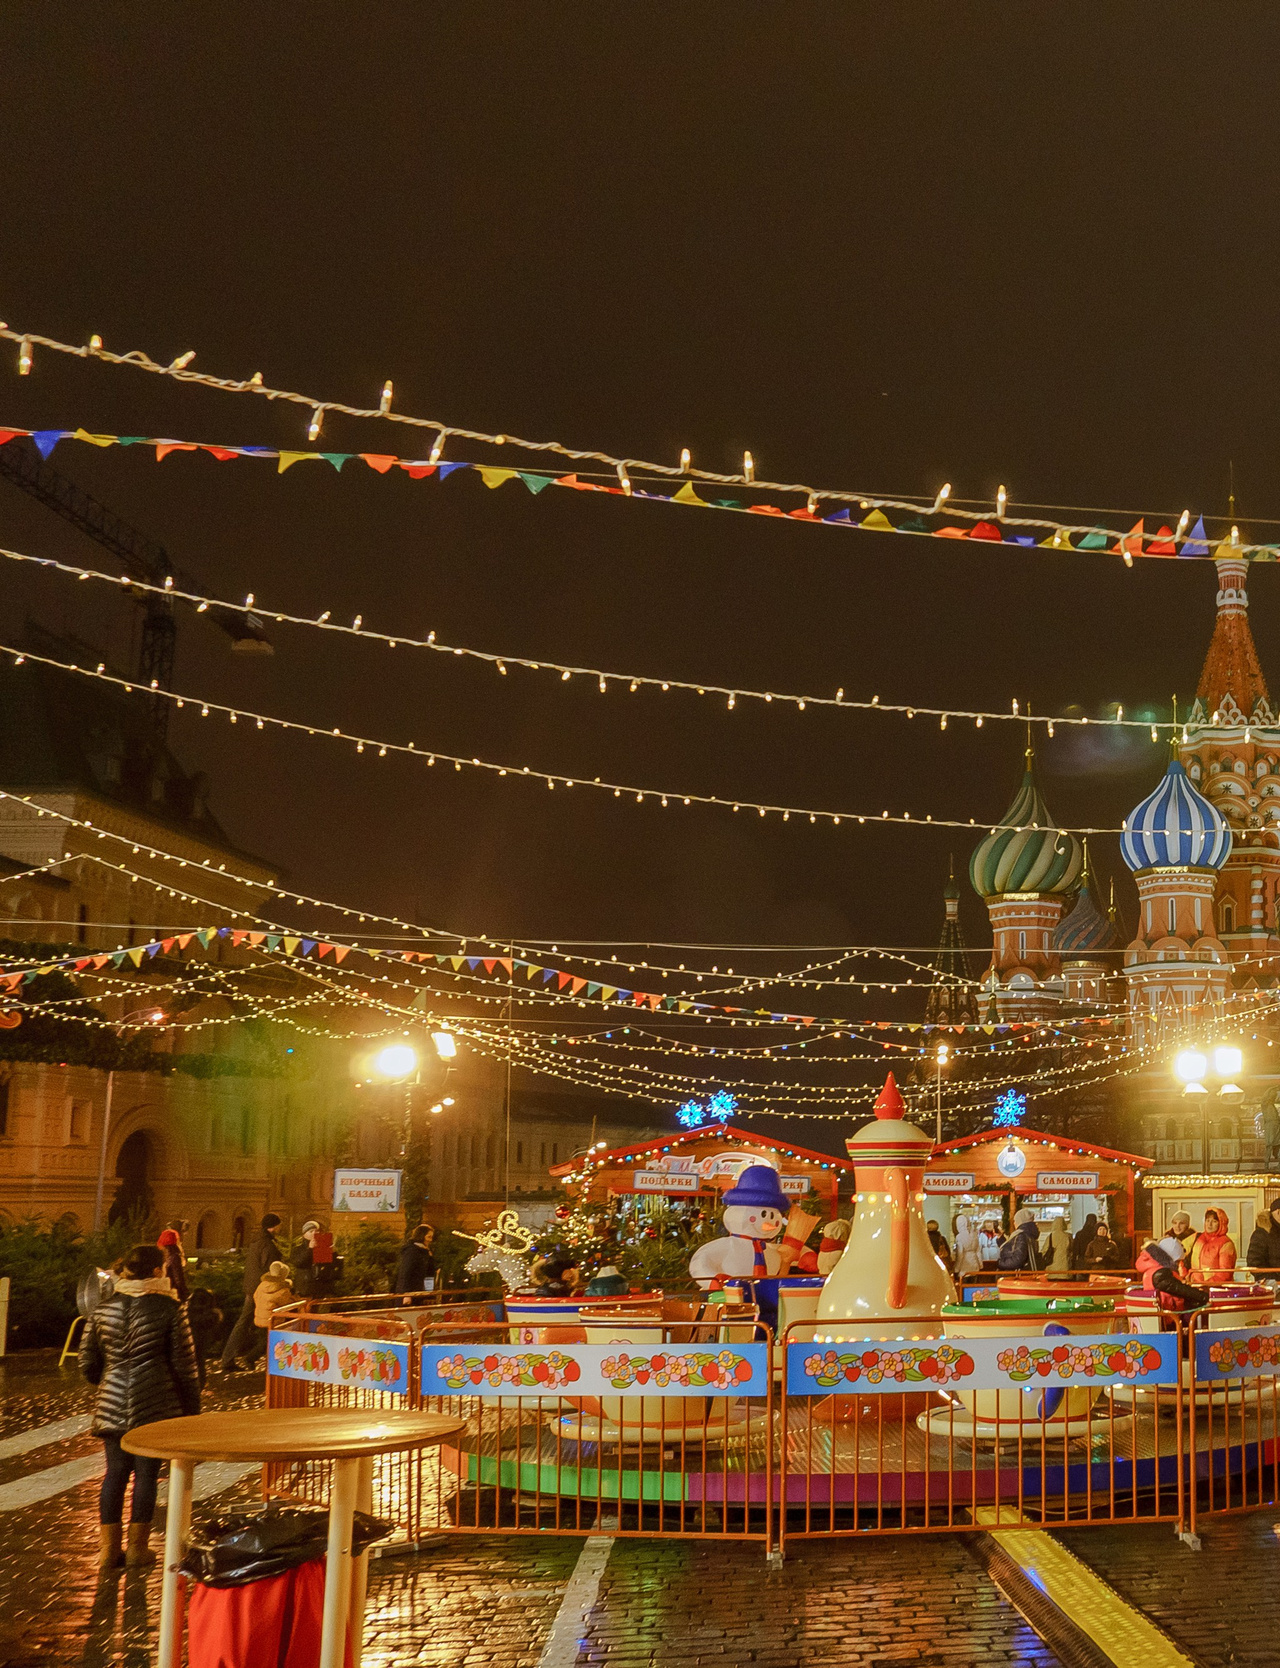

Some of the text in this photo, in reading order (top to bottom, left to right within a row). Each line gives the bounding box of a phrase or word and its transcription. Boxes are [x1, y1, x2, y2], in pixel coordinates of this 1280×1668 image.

[640, 1177, 692, 1187] ПОДАРКИ
[922, 1177, 969, 1187] АМОВАР
[1042, 1177, 1093, 1185] САМОВАР
[348, 1190, 382, 1198] БАЗАР
